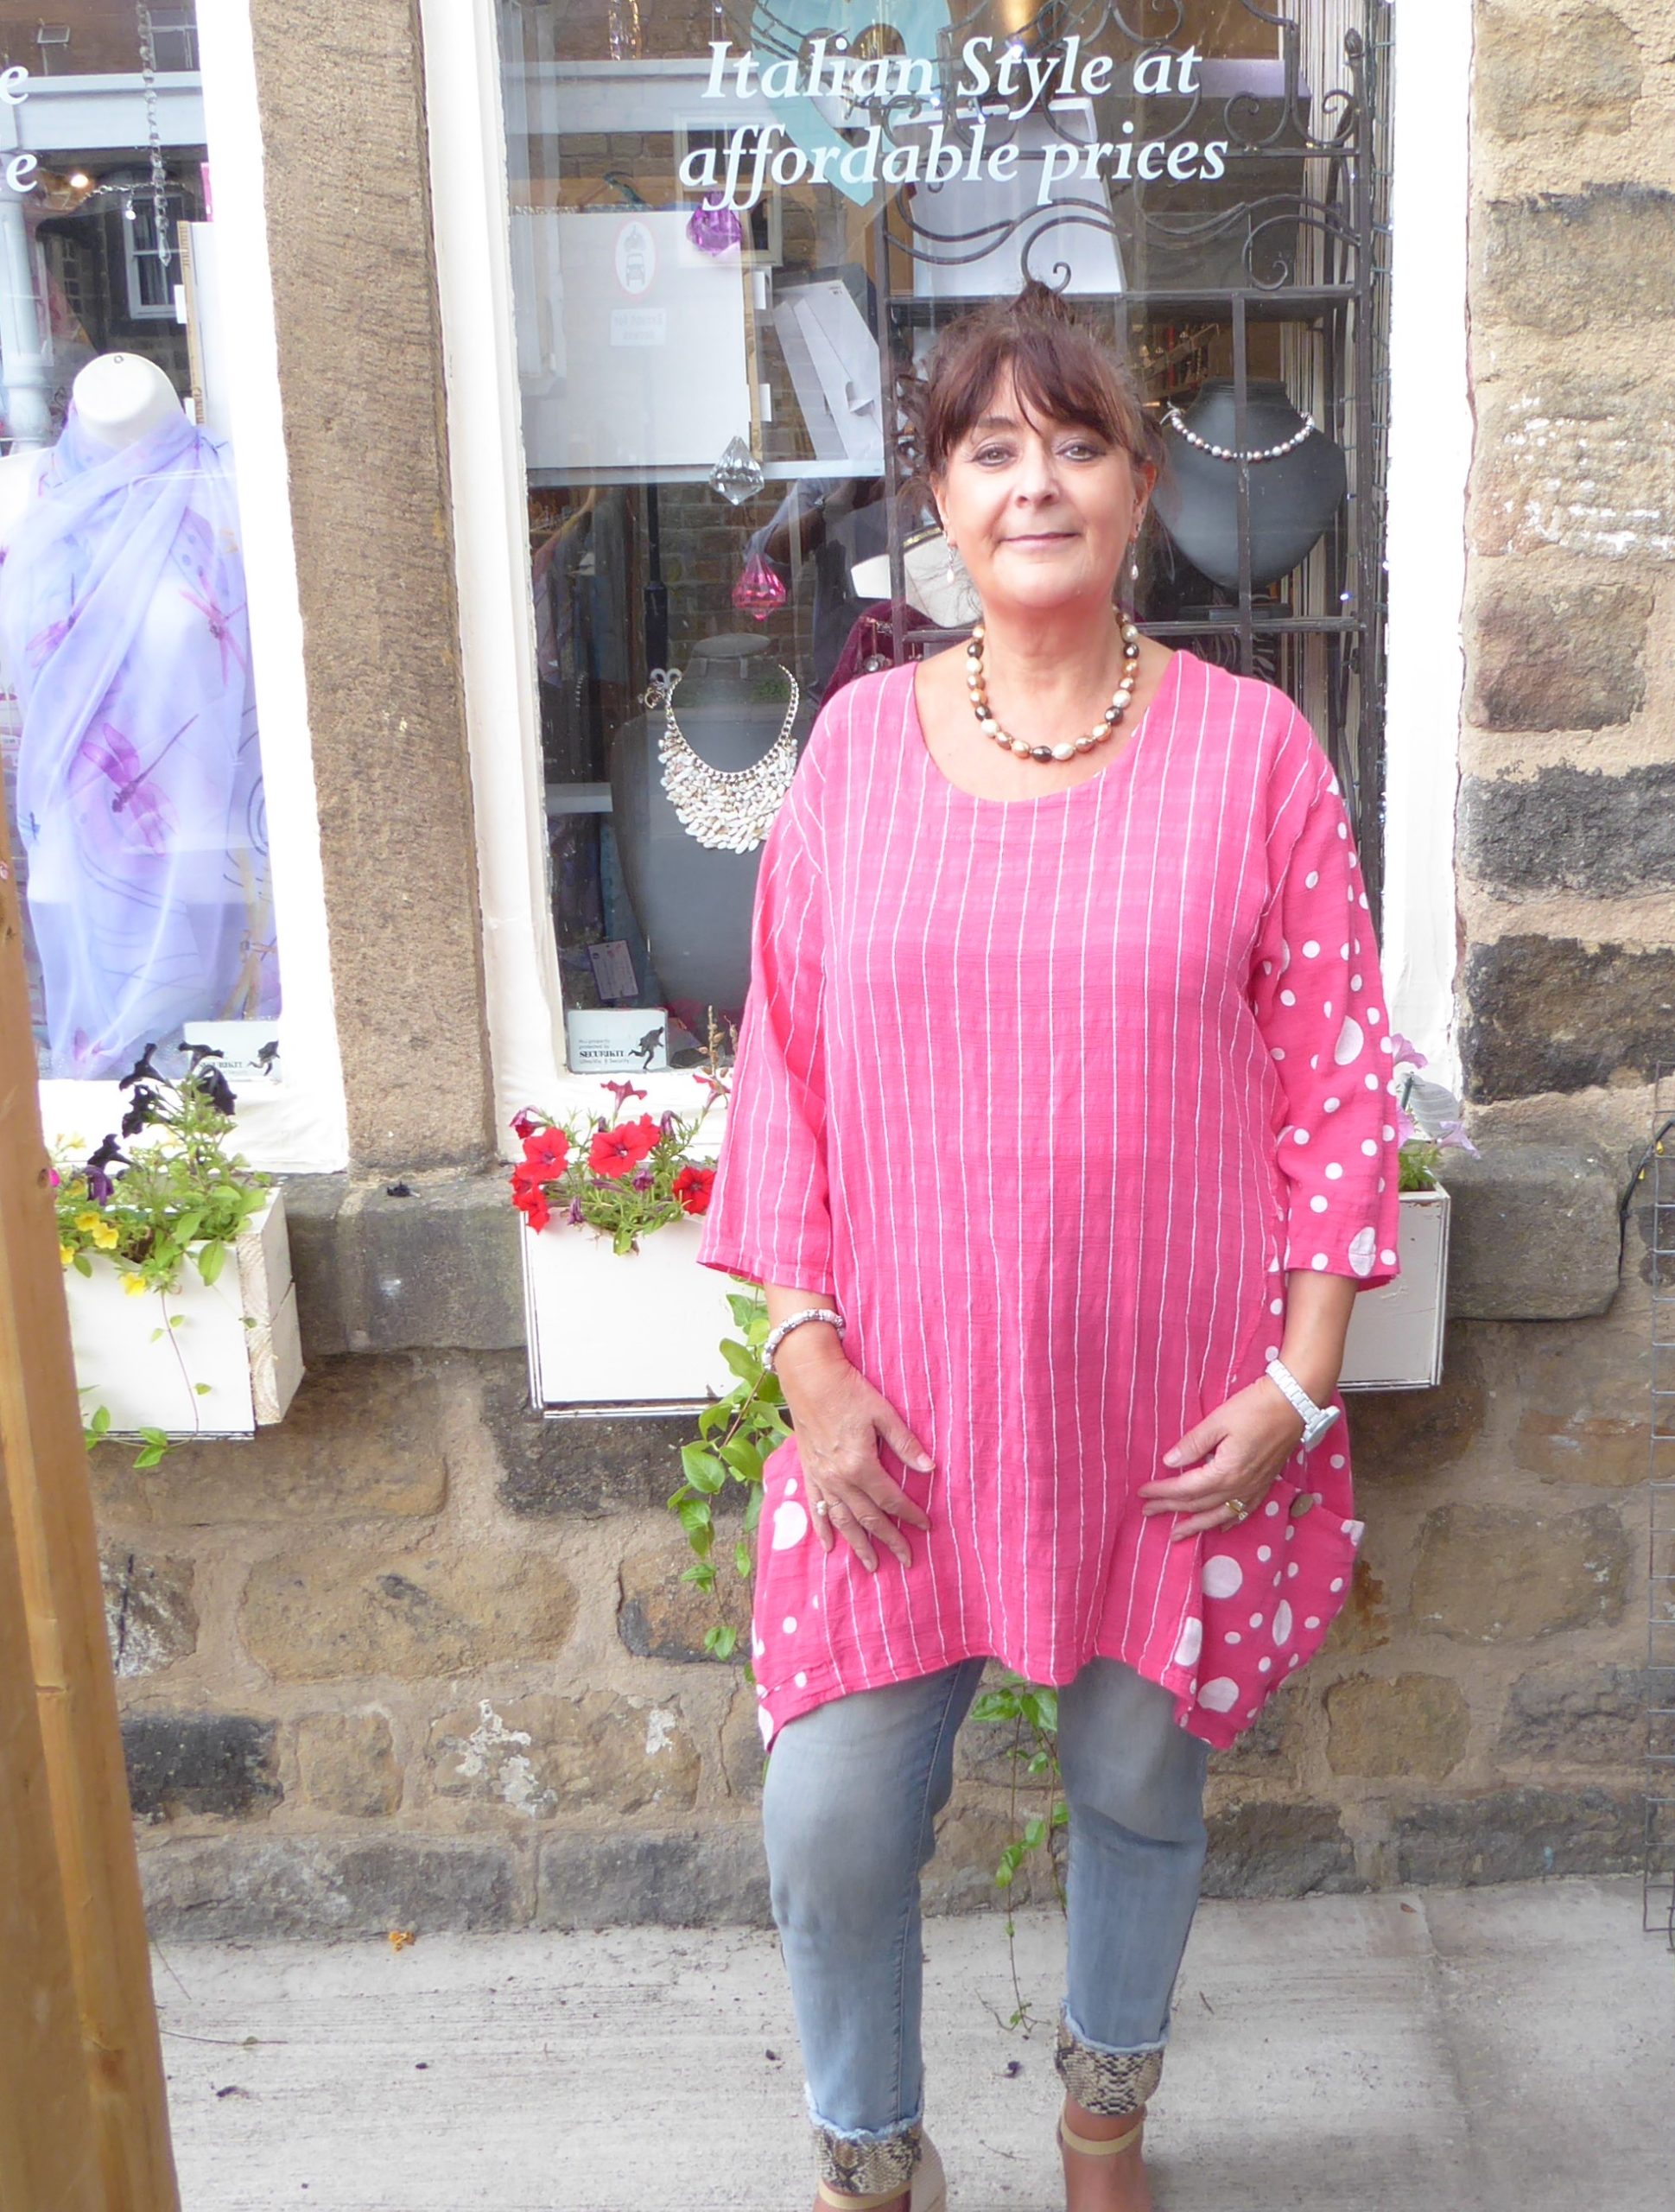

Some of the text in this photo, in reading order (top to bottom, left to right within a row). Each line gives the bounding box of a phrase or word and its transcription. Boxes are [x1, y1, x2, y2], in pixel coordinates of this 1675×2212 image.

[701, 35, 1202, 121] Italian Style at
[0, 154, 37, 193] e
[679, 121, 1228, 212] affordable prices
